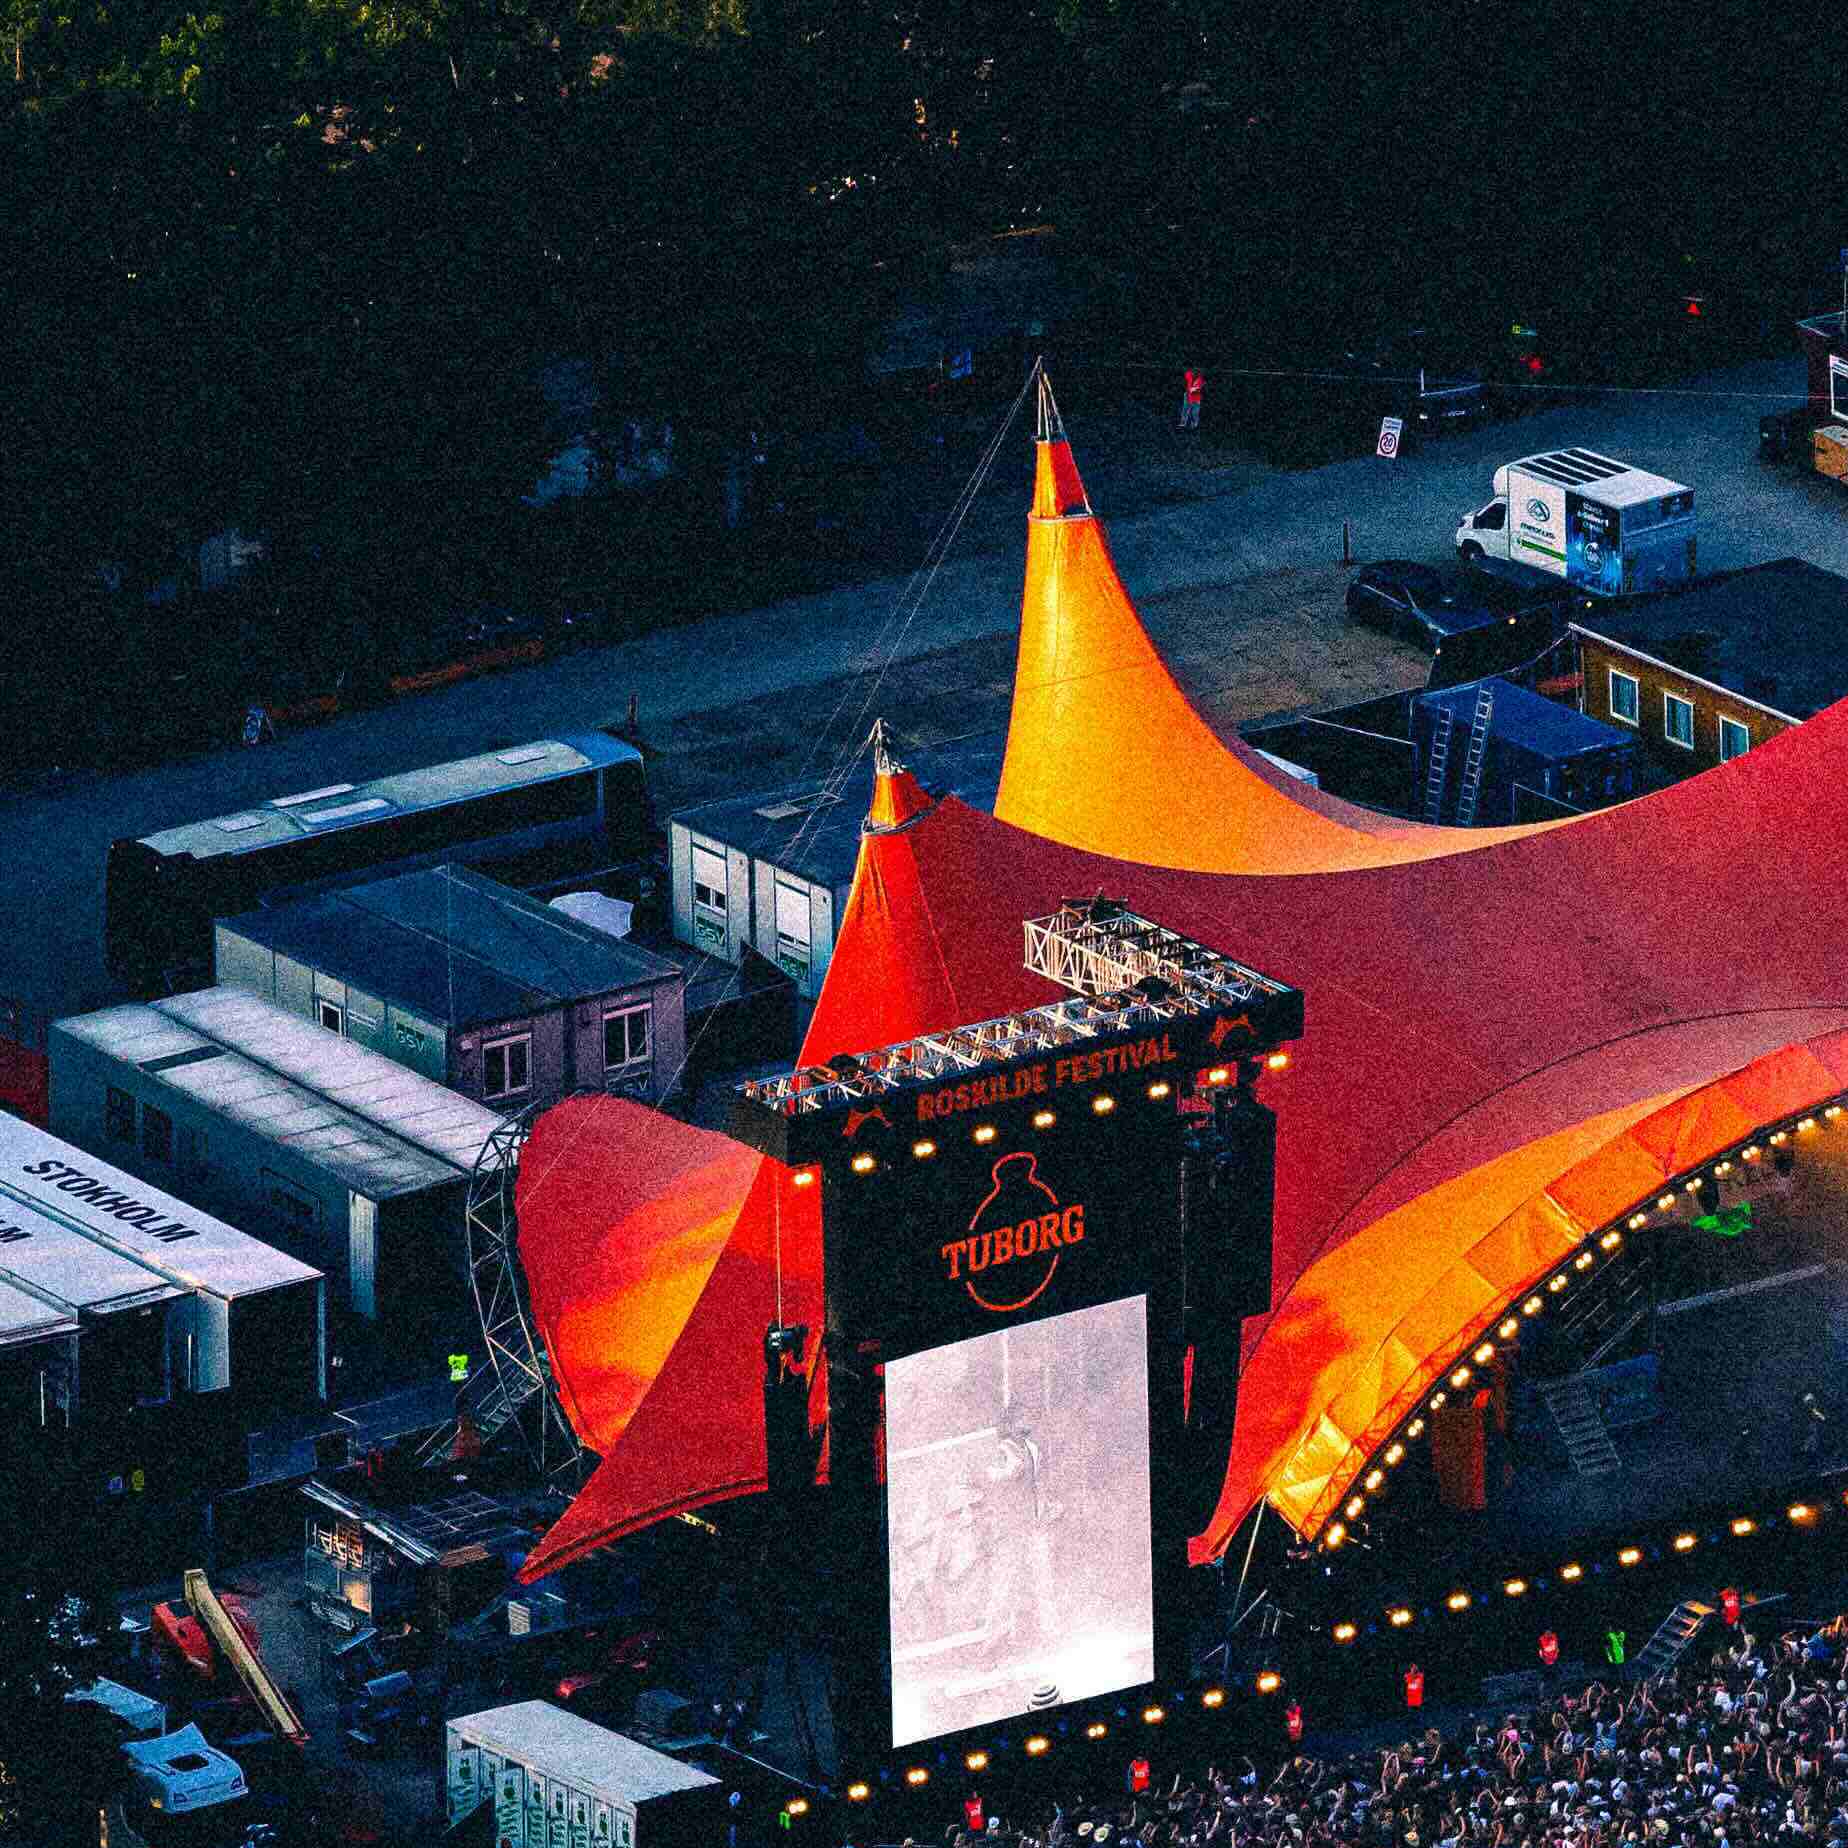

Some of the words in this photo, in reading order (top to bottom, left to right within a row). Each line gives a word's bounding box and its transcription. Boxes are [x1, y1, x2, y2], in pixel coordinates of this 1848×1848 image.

[916, 1063, 1048, 1121] ROSKILDE
[1054, 1033, 1178, 1088] FESTIVAL
[22, 1159, 201, 1243] STOKHOLM
[941, 1203, 1086, 1281] TUBORG
